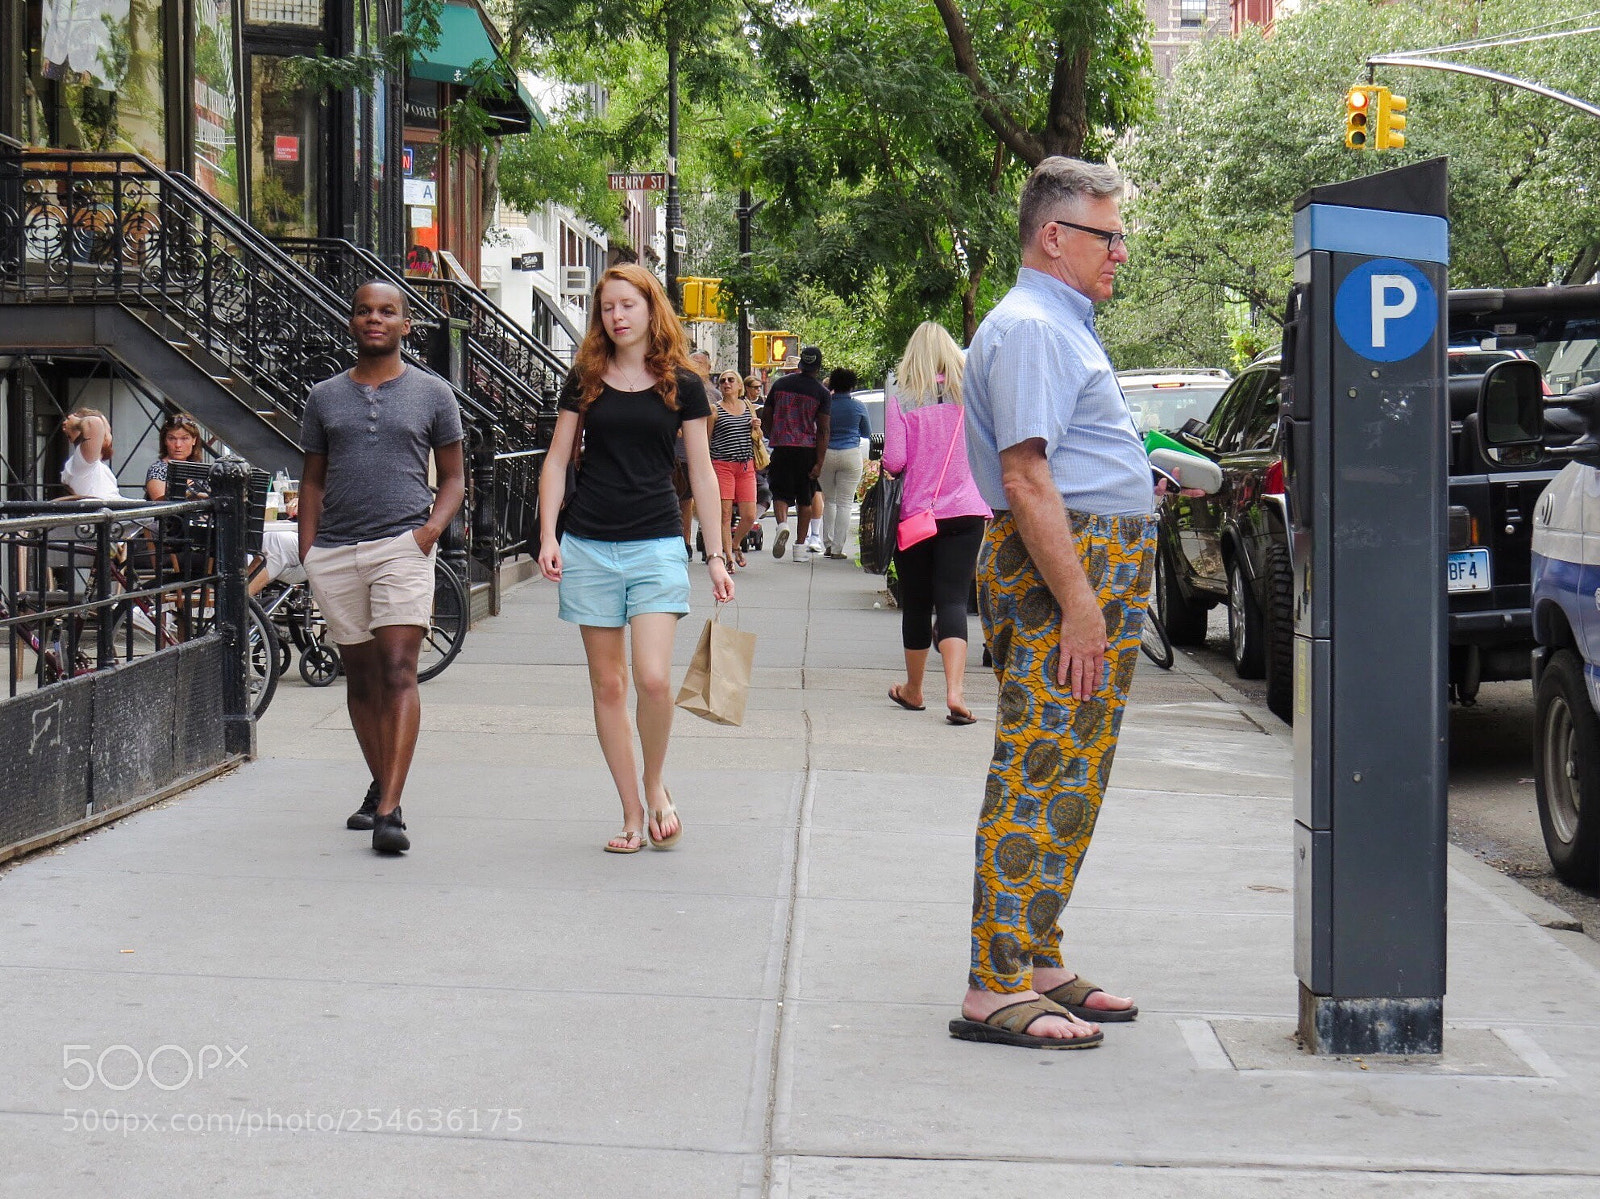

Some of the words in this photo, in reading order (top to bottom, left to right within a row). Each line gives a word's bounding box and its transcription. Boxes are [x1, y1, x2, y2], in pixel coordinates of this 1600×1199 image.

[611, 175, 646, 190] HENRY
[650, 175, 663, 190] ST
[423, 184, 433, 199] A
[1371, 274, 1417, 347] P
